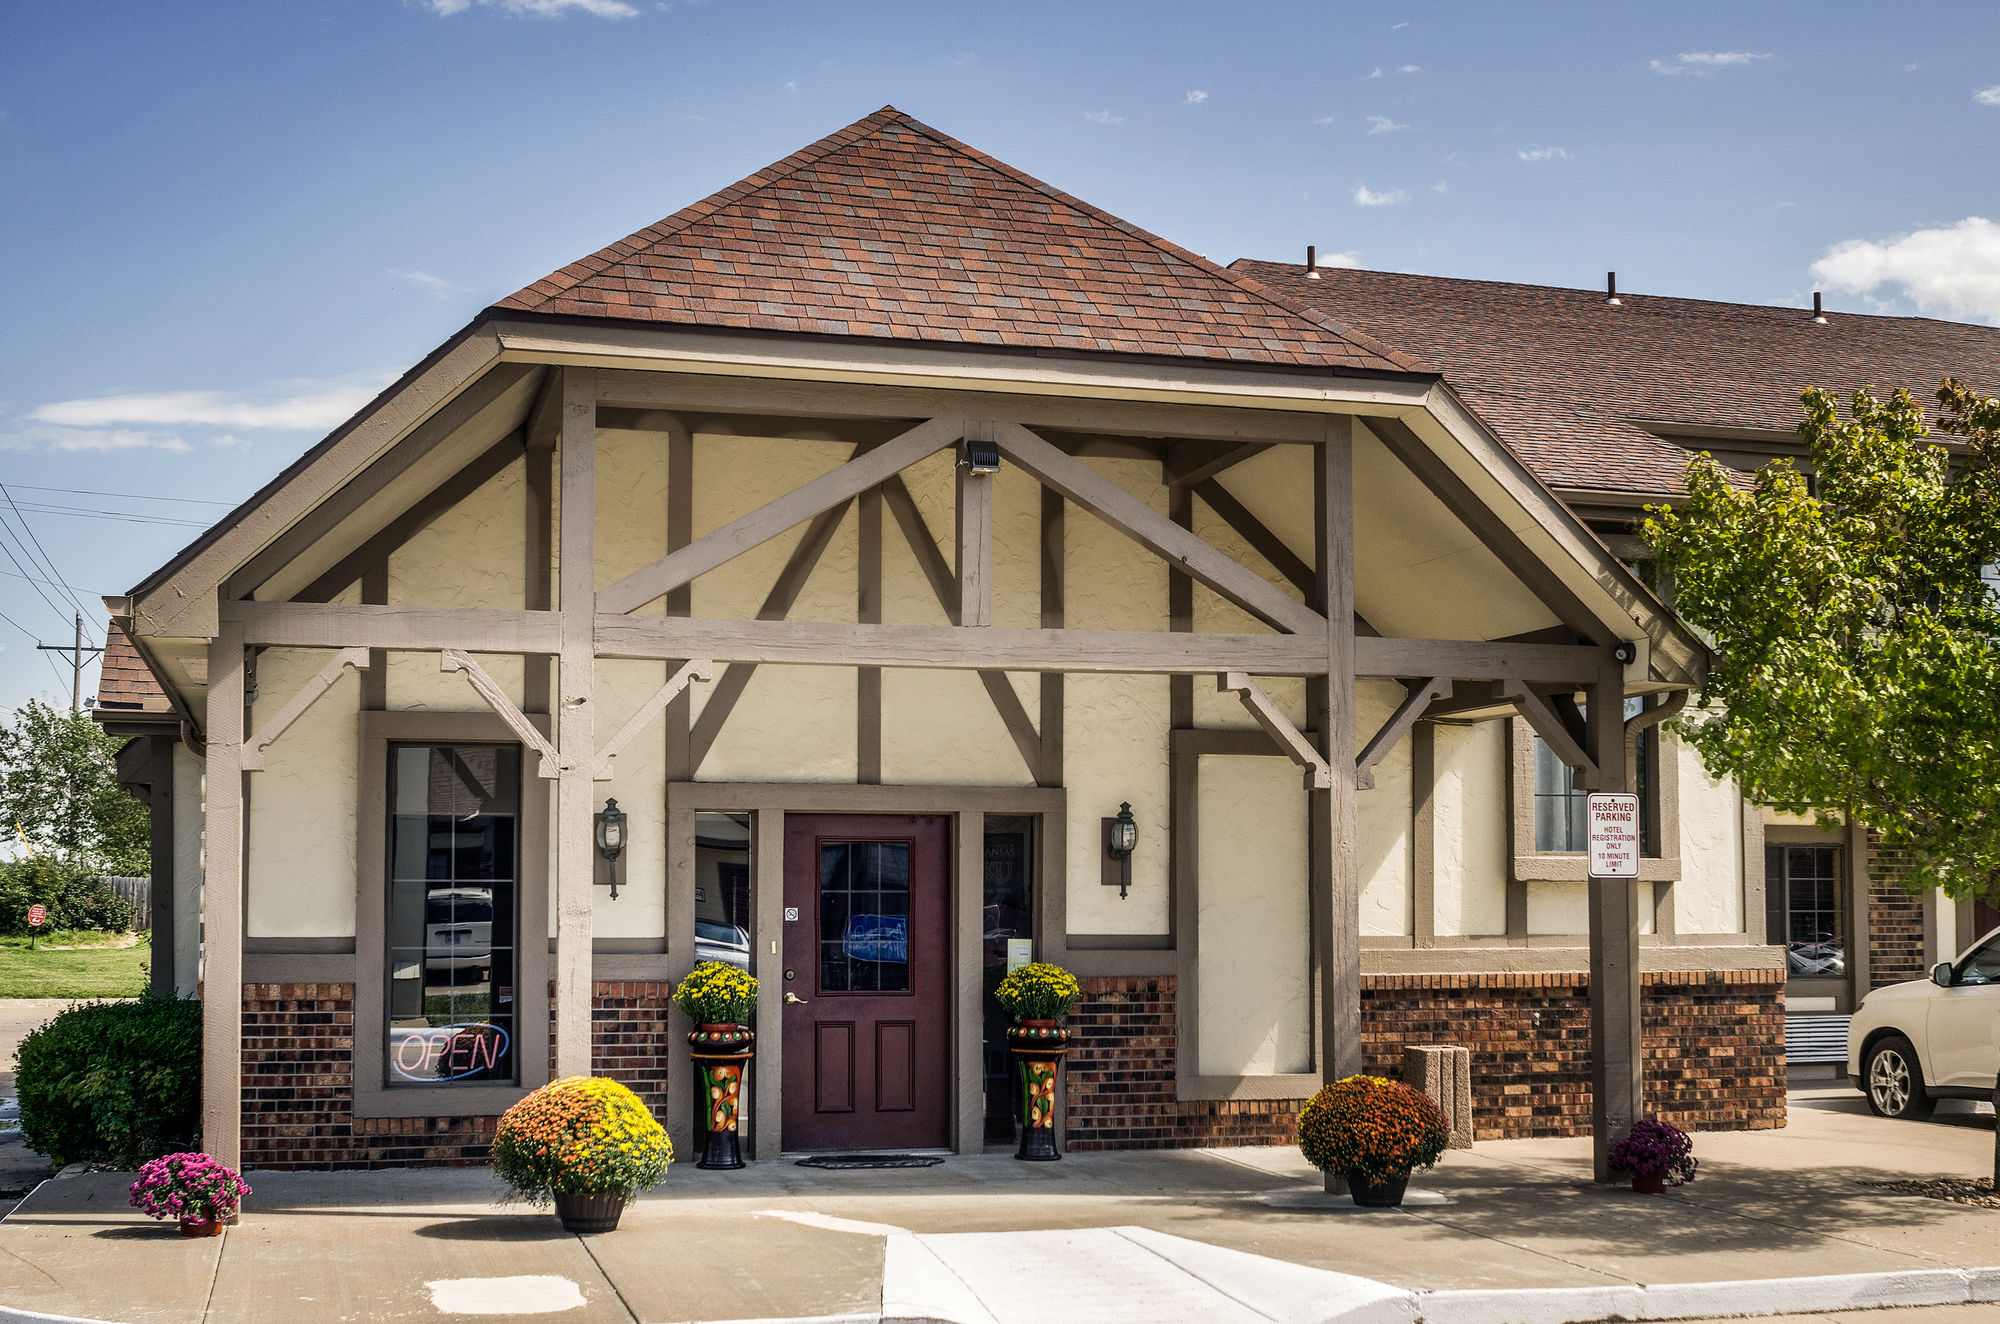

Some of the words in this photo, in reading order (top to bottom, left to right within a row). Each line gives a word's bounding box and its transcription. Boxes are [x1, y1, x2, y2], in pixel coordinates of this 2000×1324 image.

[1592, 803, 1634, 811] RESERVED
[1595, 813, 1631, 821] PARKING
[985, 847, 1016, 857] ANSAS
[398, 1034, 500, 1071] OPEN
